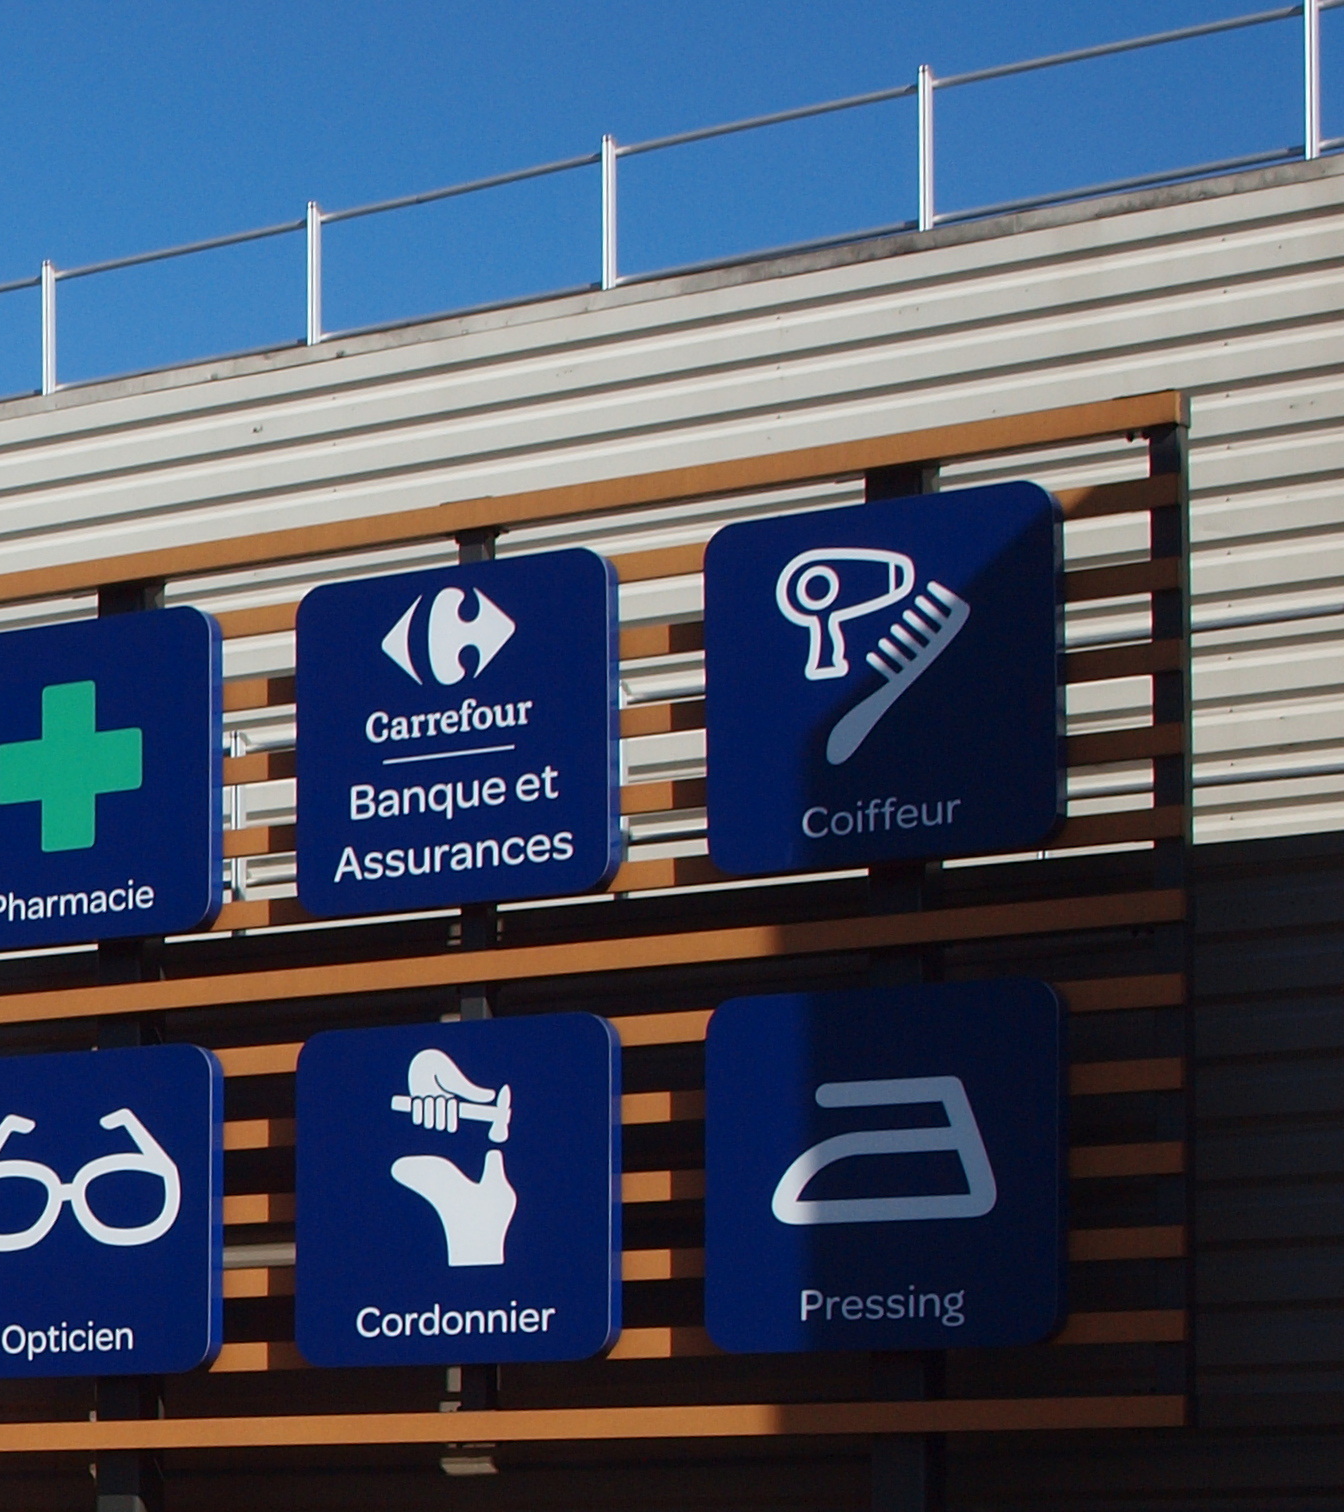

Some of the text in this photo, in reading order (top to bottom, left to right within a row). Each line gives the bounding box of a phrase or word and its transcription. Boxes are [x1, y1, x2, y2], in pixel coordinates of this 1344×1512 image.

[365, 697, 533, 744] Carrefour
[350, 764, 560, 821] Banque et
[801, 797, 962, 838] Coiffeur
[334, 831, 574, 883] Assurances
[356, 1300, 556, 1339] Cordonnier
[800, 1284, 965, 1328] Pressing
[1, 1321, 135, 1361] Opticien
